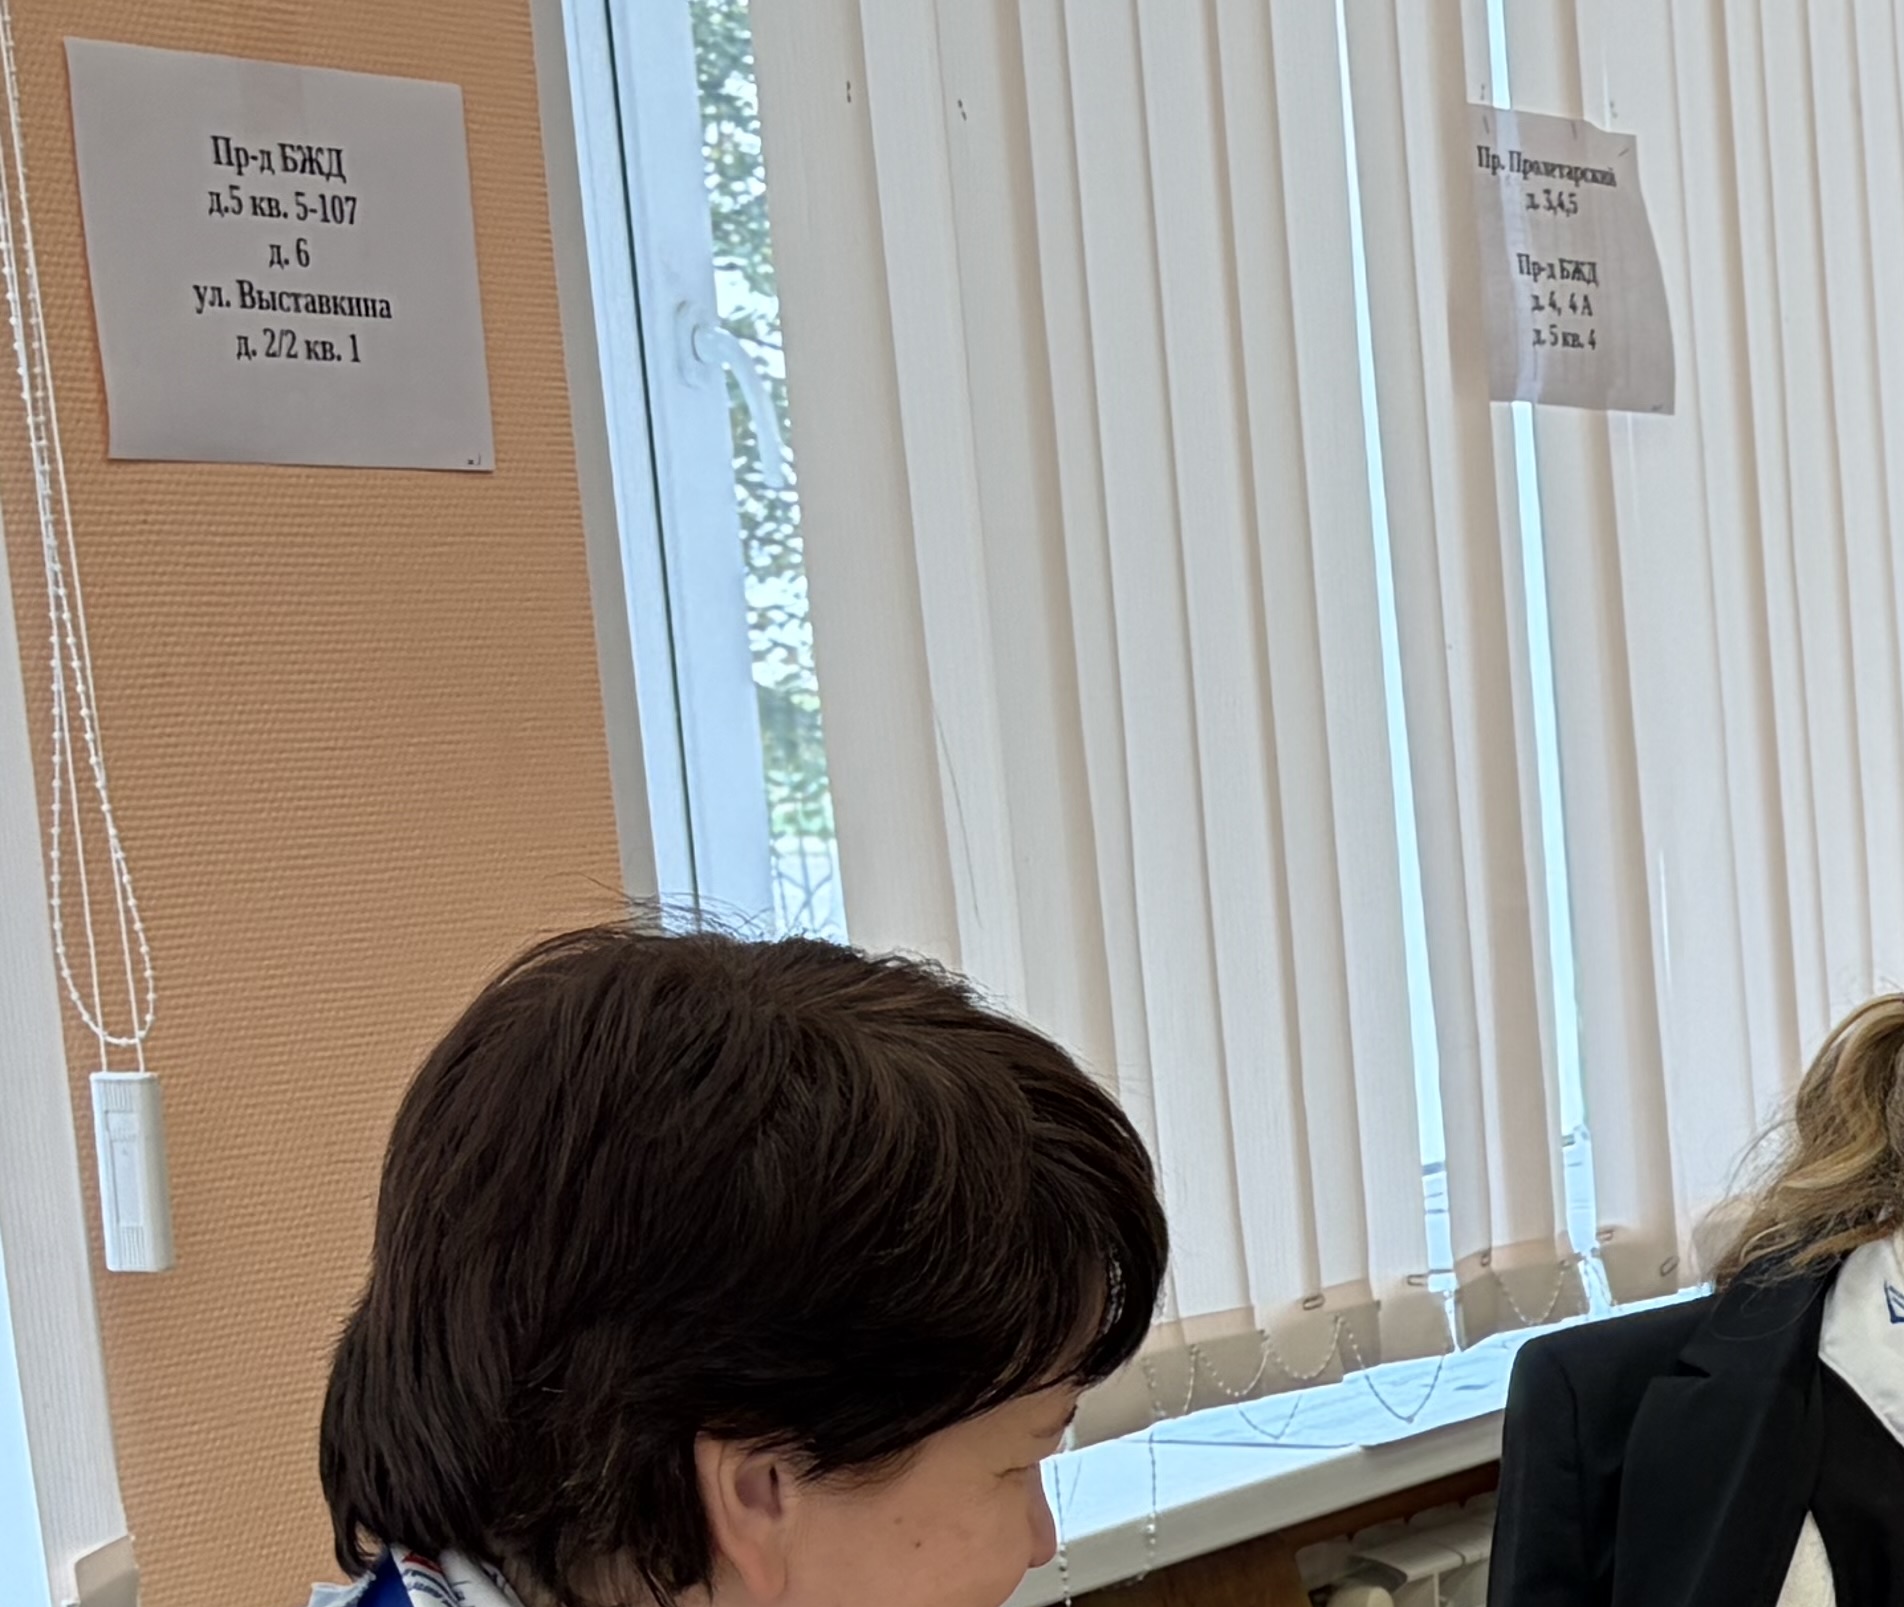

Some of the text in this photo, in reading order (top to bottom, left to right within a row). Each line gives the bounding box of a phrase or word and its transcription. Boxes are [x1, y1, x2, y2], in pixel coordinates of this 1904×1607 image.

[211, 135, 347, 184] Пр-д БЖД
[208, 184, 357, 225] д.5 кв. 5-107
[269, 238, 310, 270] д. 6
[1558, 258, 1599, 287] БЖД
[192, 279, 392, 319] ул. Выставкина
[236, 328, 360, 363] д. 2/2 кв. 1
[1562, 331, 1584, 349] кв.
